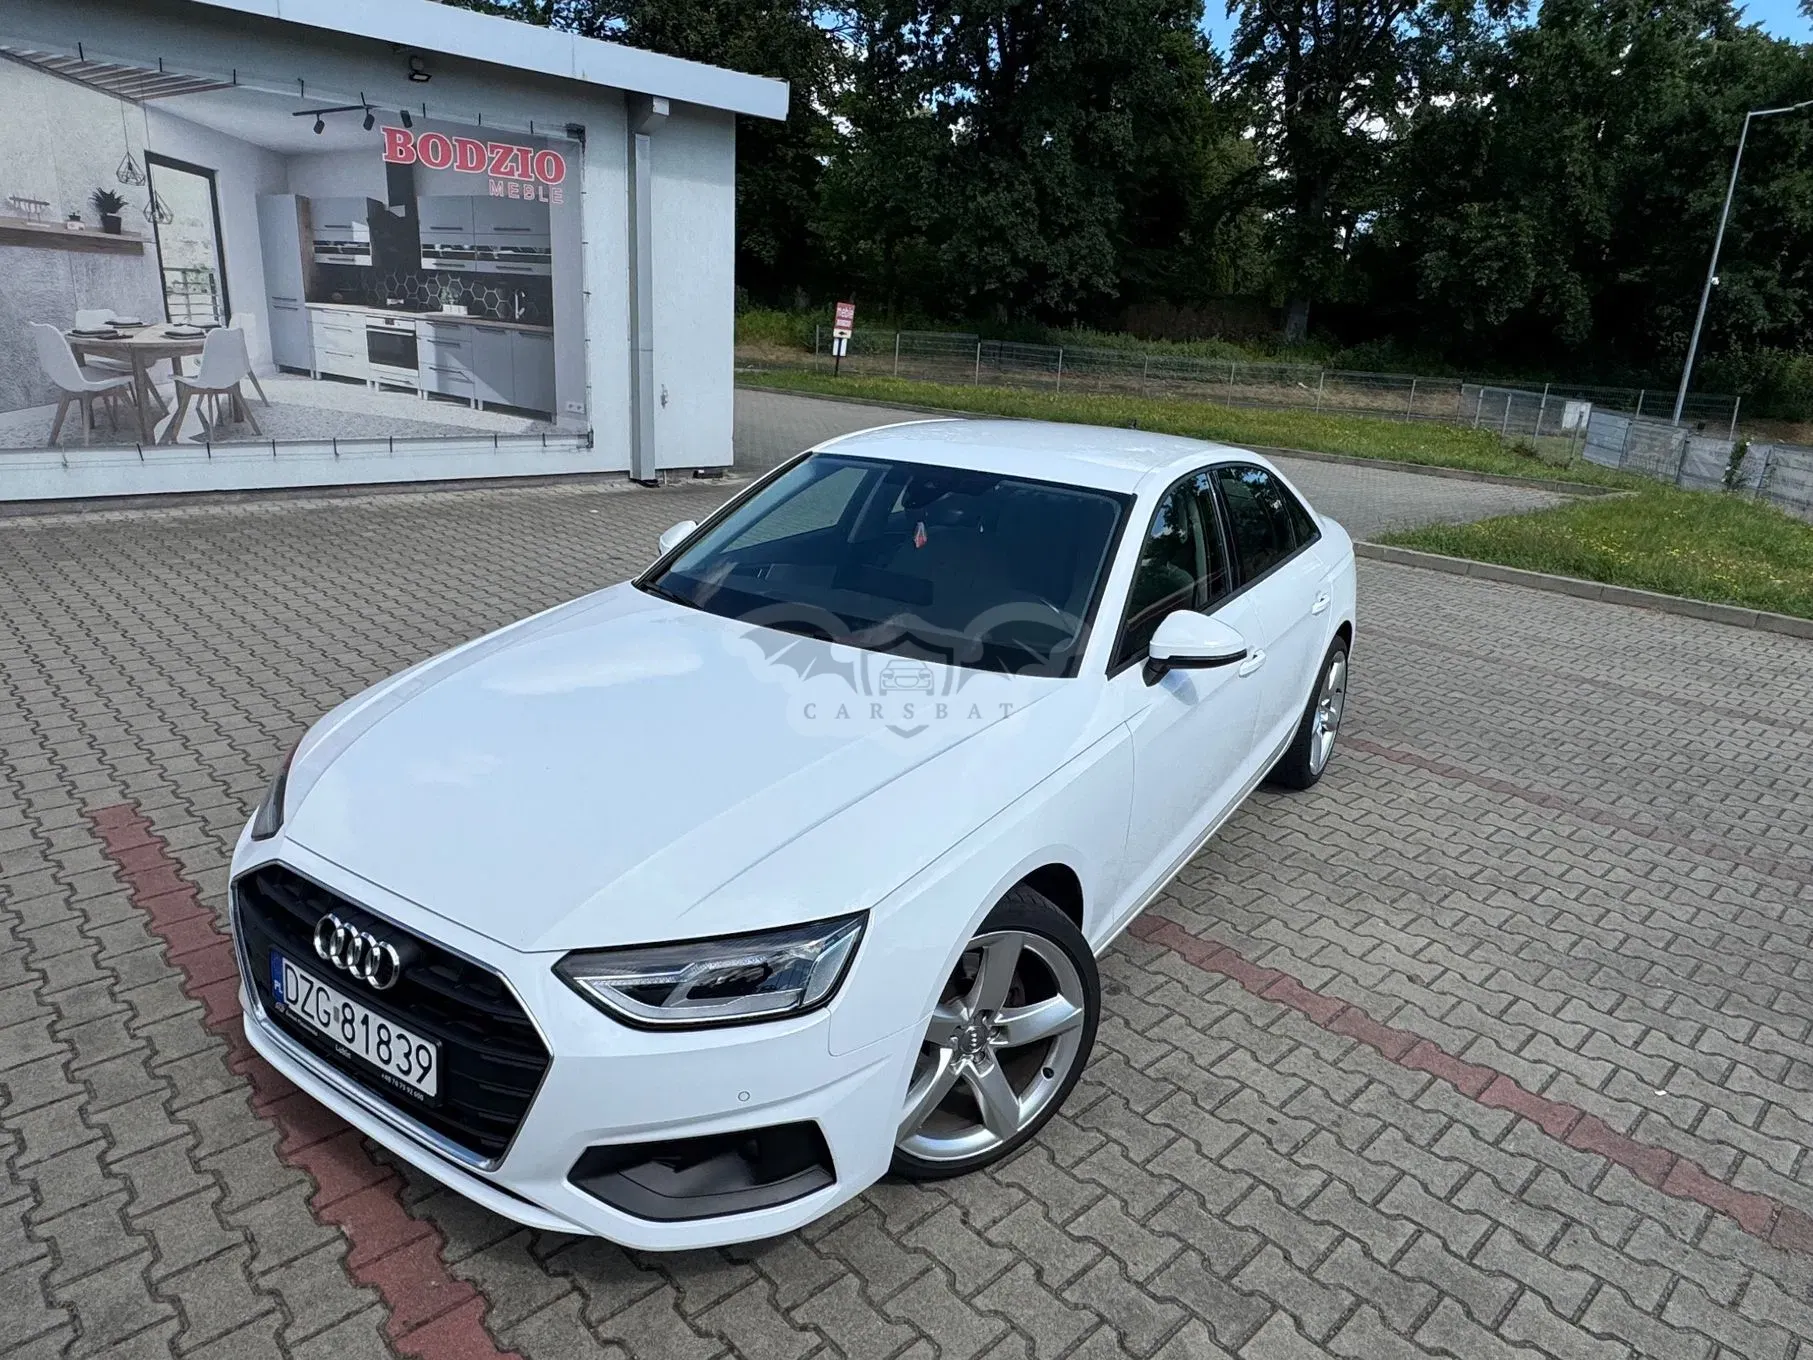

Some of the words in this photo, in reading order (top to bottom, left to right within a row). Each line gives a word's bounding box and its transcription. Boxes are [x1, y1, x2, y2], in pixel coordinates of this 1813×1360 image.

[380, 126, 566, 185] BODZIO
[489, 179, 564, 204] MEBLE
[274, 979, 283, 994] PL
[285, 963, 331, 1028] DZG
[341, 1002, 433, 1085] 81839
